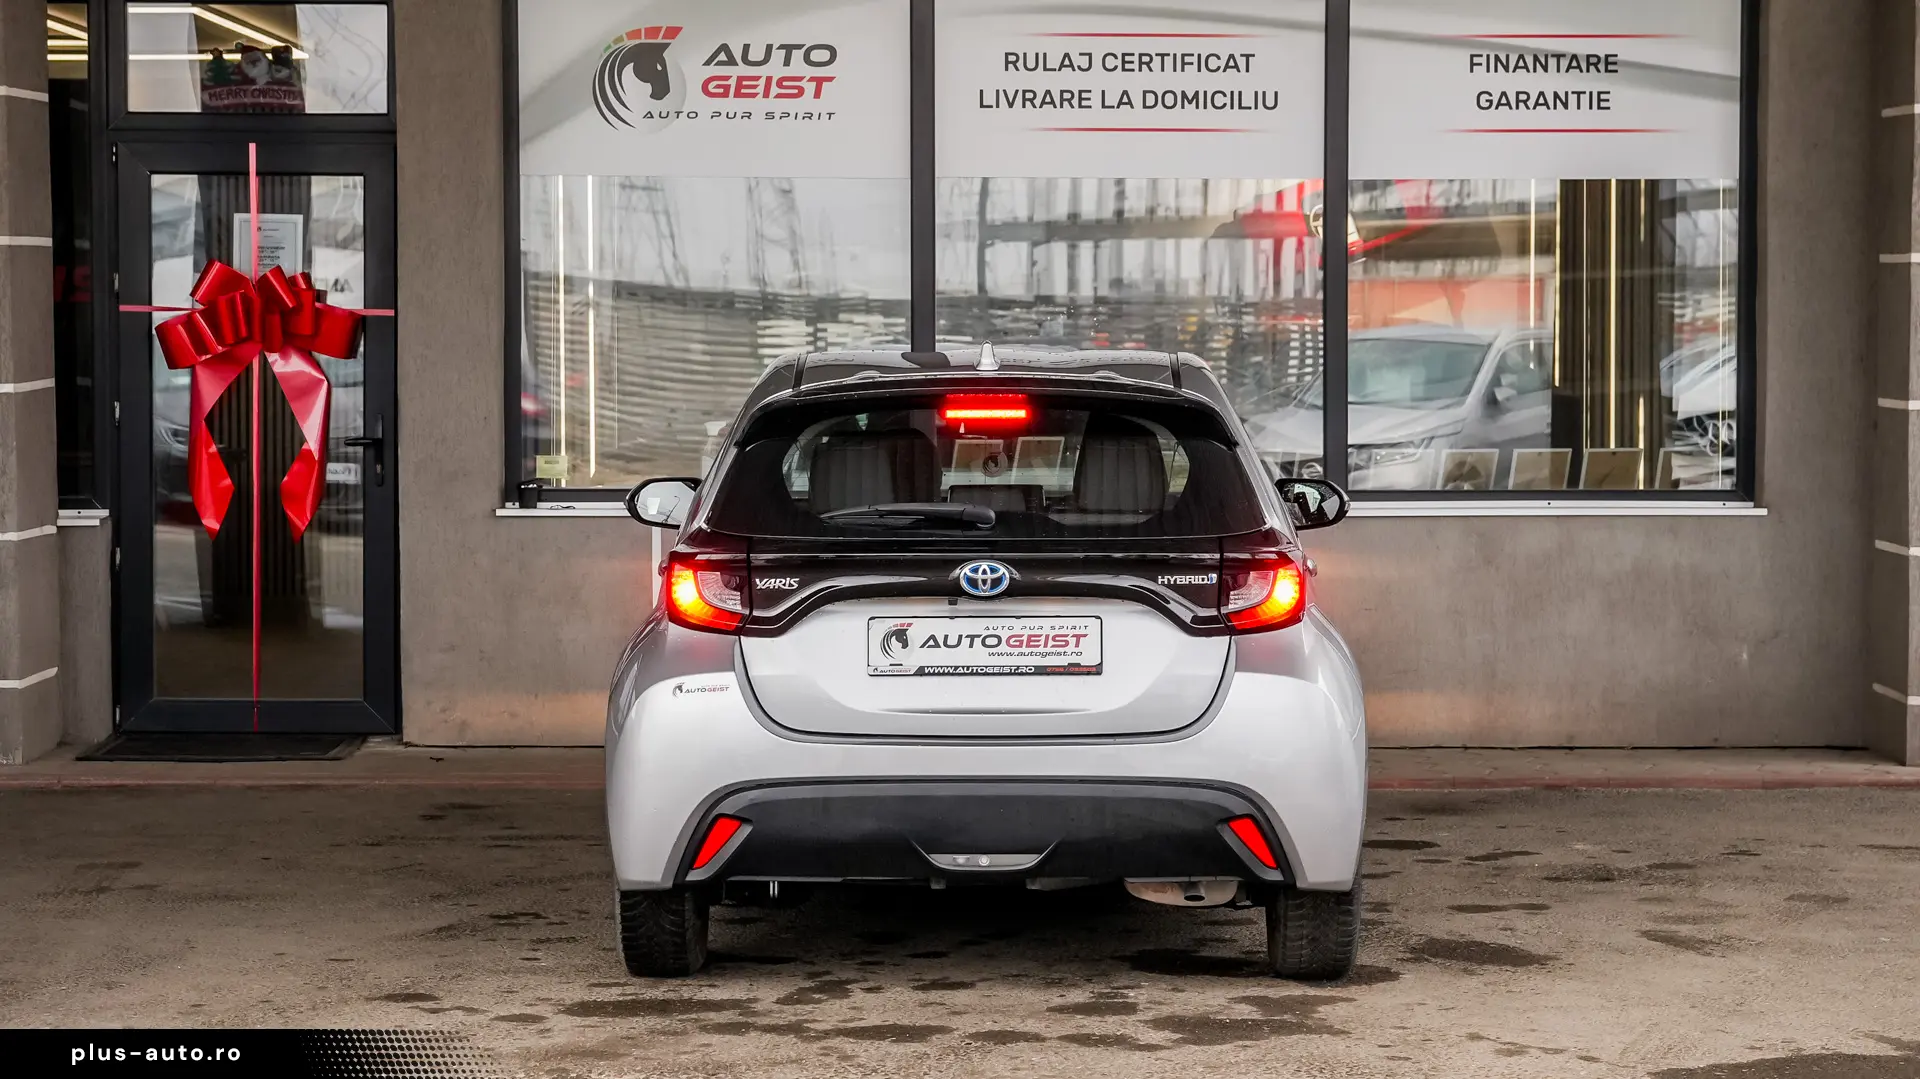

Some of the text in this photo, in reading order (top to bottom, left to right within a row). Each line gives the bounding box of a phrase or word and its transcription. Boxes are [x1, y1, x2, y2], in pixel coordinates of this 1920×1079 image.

[701, 42, 838, 68] AUTO
[1004, 52, 1255, 73] RULAJ CERTIFICAT
[1469, 53, 1619, 74] FINANTARE
[208, 88, 250, 102] MERRY
[701, 75, 837, 99] GEIST
[979, 88, 1279, 111] LIVRARE LA DOMICILIU
[1476, 90, 1611, 111] GARANTIE
[642, 110, 837, 121] AUTO PUR SPIRIT
[755, 577, 800, 590] YARIS
[1158, 575, 1209, 585] HYBRID
[987, 650, 1083, 658] www.autogeist.ro
[924, 666, 1035, 674] WWW.AUTOGEIST.RO
